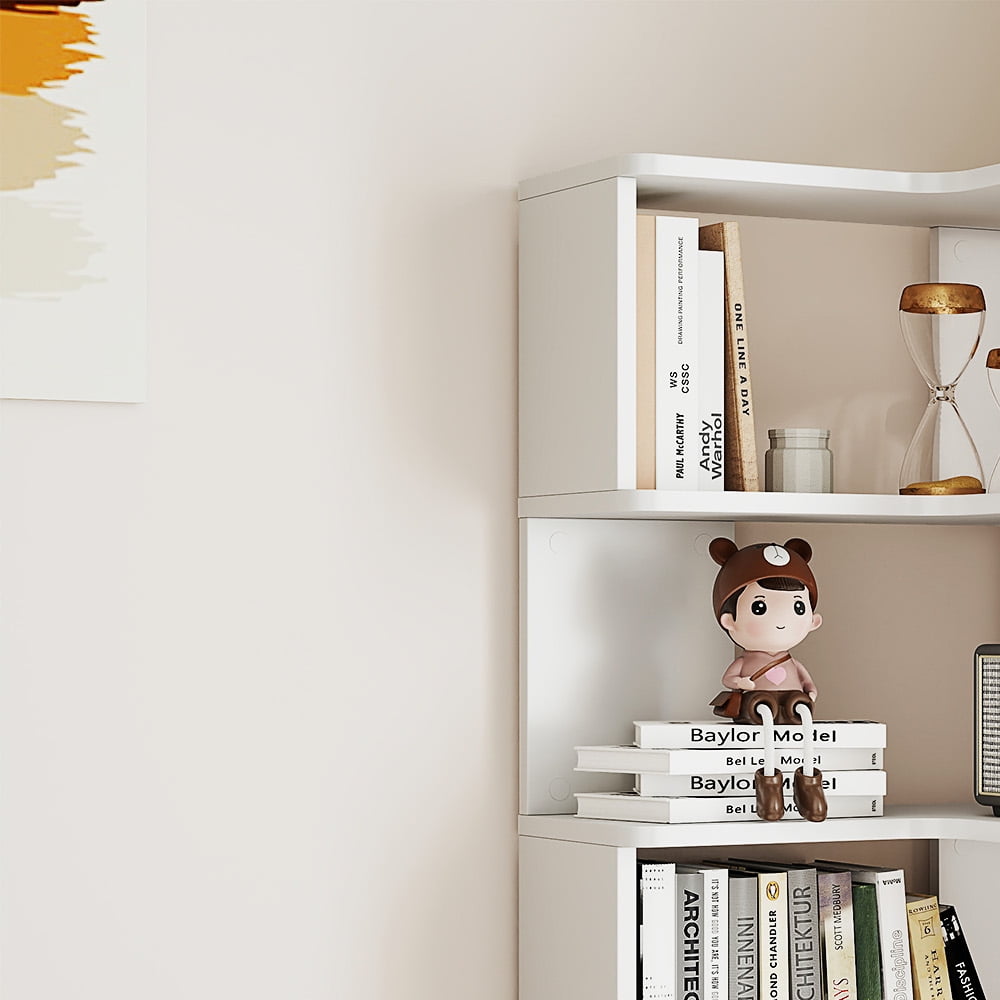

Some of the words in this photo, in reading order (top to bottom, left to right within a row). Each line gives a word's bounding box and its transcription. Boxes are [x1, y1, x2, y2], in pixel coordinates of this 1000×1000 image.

[734, 303, 744, 331] ONE
[736, 337, 748, 370] LINE
[669, 371, 678, 388] WS
[681, 363, 690, 394] CSSC
[739, 375, 748, 384] A
[740, 389, 751, 416] DAY
[675, 412, 685, 456] McCARTHY
[699, 420, 714, 472] Andy
[710, 413, 722, 480] Warhol
[675, 458, 684, 479] PAUL
[691, 728, 761, 746] Baylor
[726, 756, 746, 766] Bel
[726, 804, 746, 814] Bel
[711, 891, 719, 903] NOT
[831, 883, 842, 924] MEDBURY
[711, 904, 719, 918] HOW
[768, 910, 778, 969] CHANDLER
[834, 925, 843, 951] SCOTT
[924, 925, 931, 935] 6
[711, 936, 719, 948] YOU
[711, 976, 719, 990] HOW
